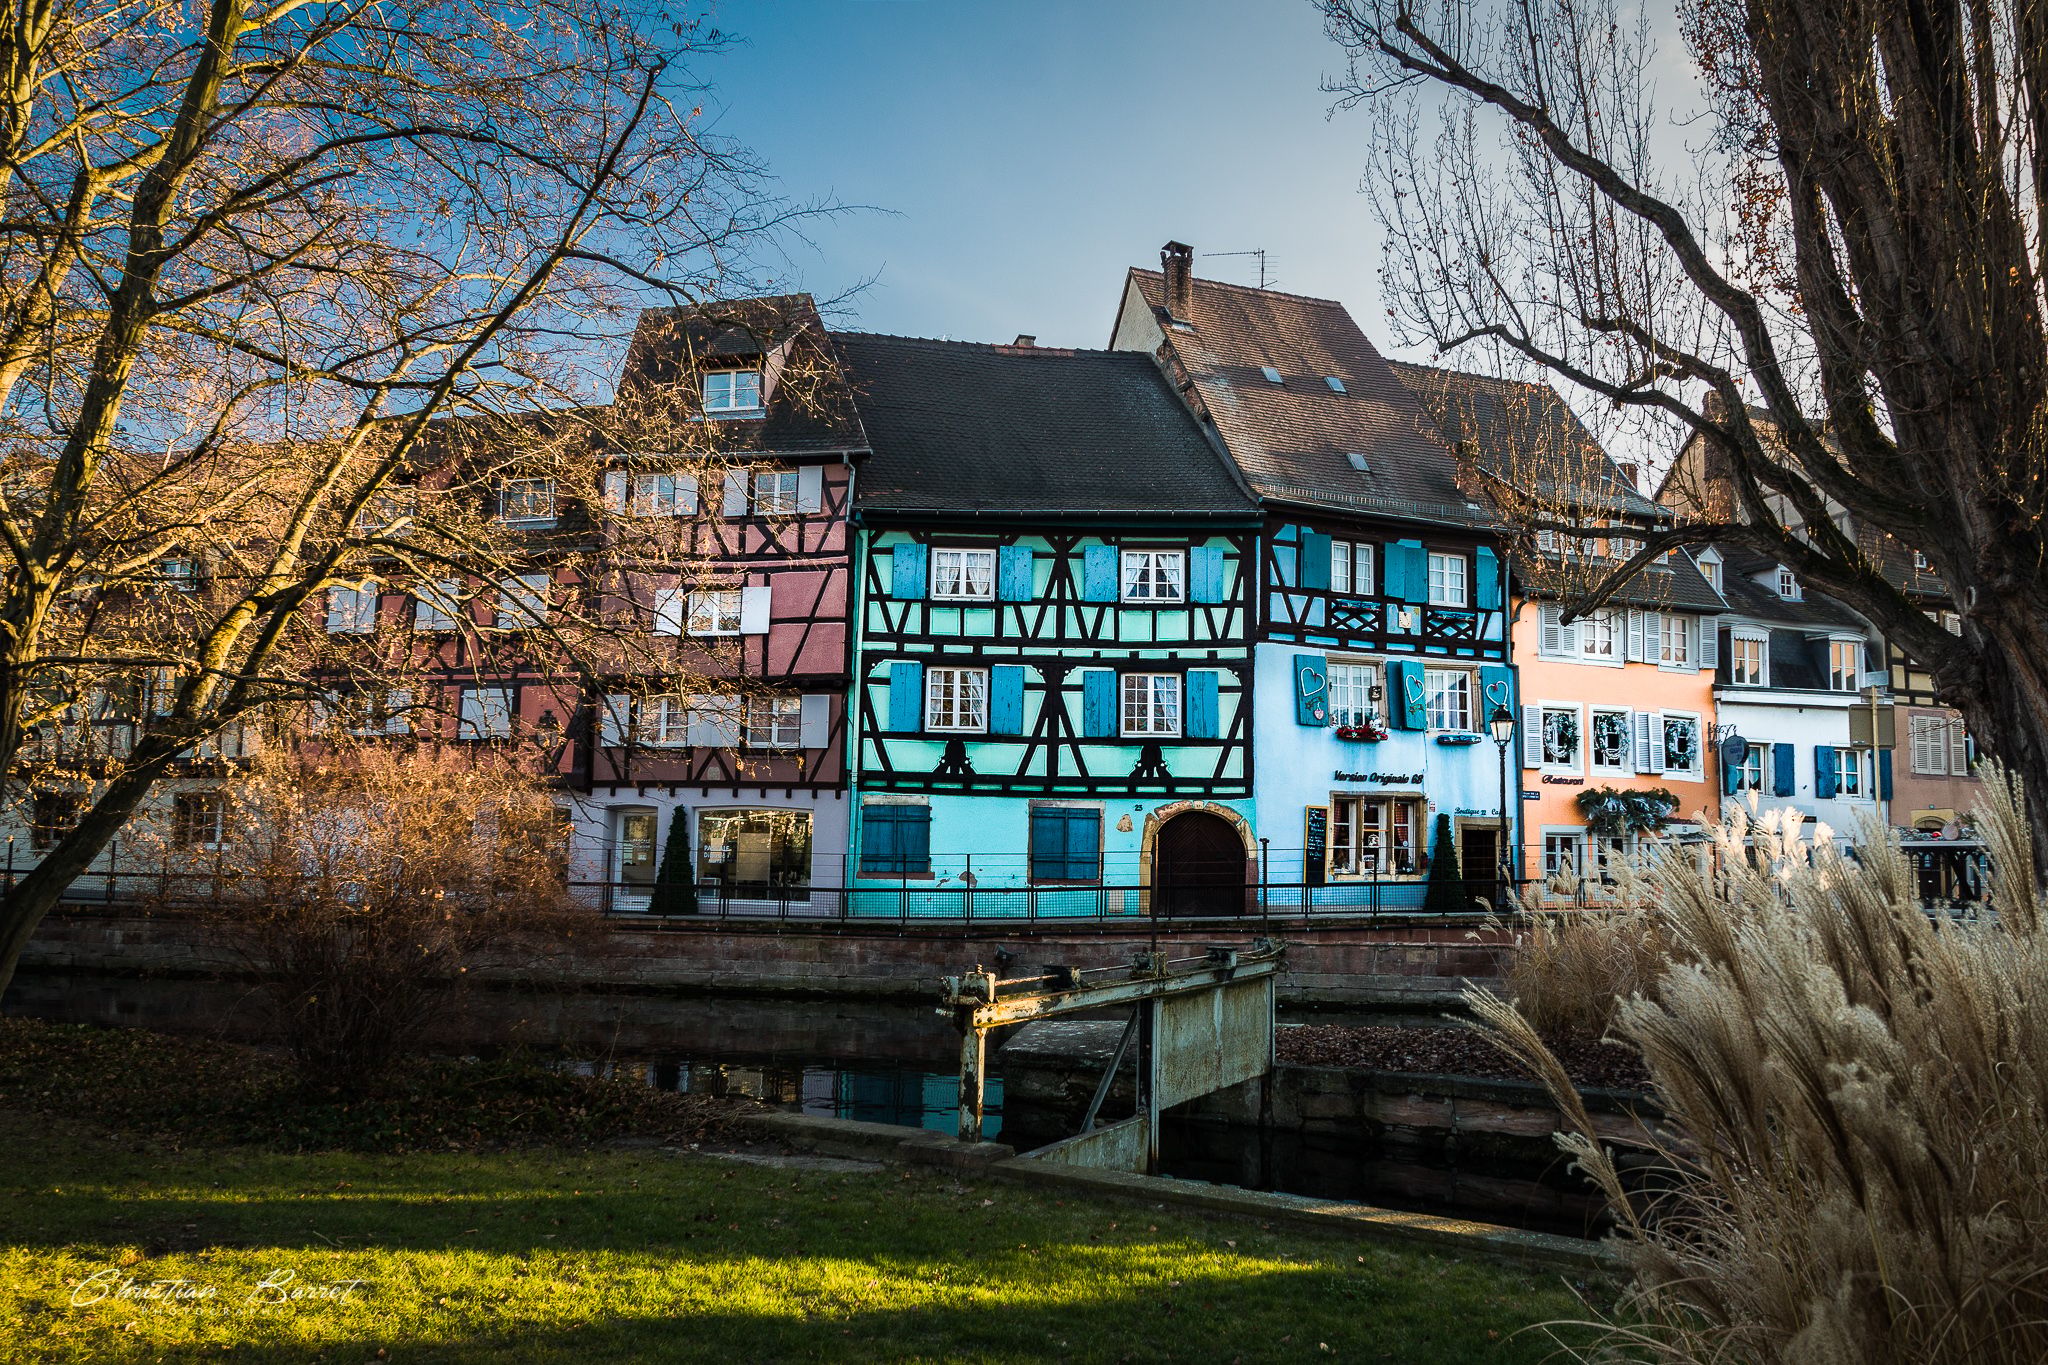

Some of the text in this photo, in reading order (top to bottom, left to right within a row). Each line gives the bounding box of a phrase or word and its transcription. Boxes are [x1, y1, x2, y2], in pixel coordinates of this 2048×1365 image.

[1334, 770, 1424, 786] Version Originale 68
[1542, 774, 1585, 786] Restaurant
